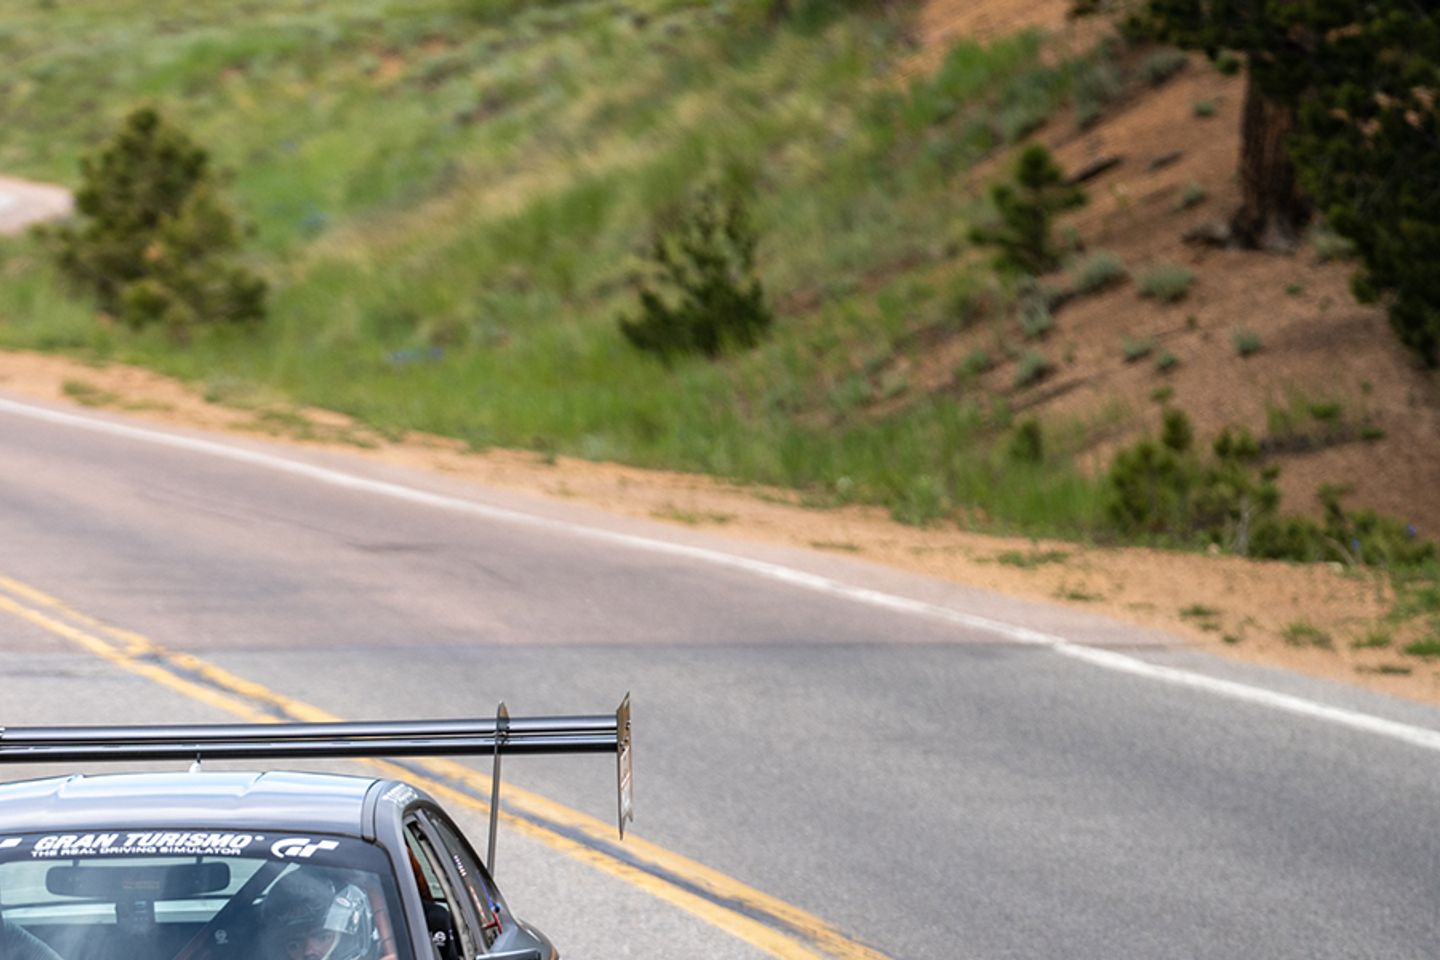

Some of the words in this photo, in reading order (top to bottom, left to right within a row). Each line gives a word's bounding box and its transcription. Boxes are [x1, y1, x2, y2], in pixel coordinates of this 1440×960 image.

[34, 834, 118, 850] GRAN
[125, 832, 254, 849] TURISMO
[31, 850, 58, 858] THE
[60, 848, 97, 856] REAL
[100, 846, 157, 855] DRIVING
[160, 846, 242, 855] SIMULATOR
